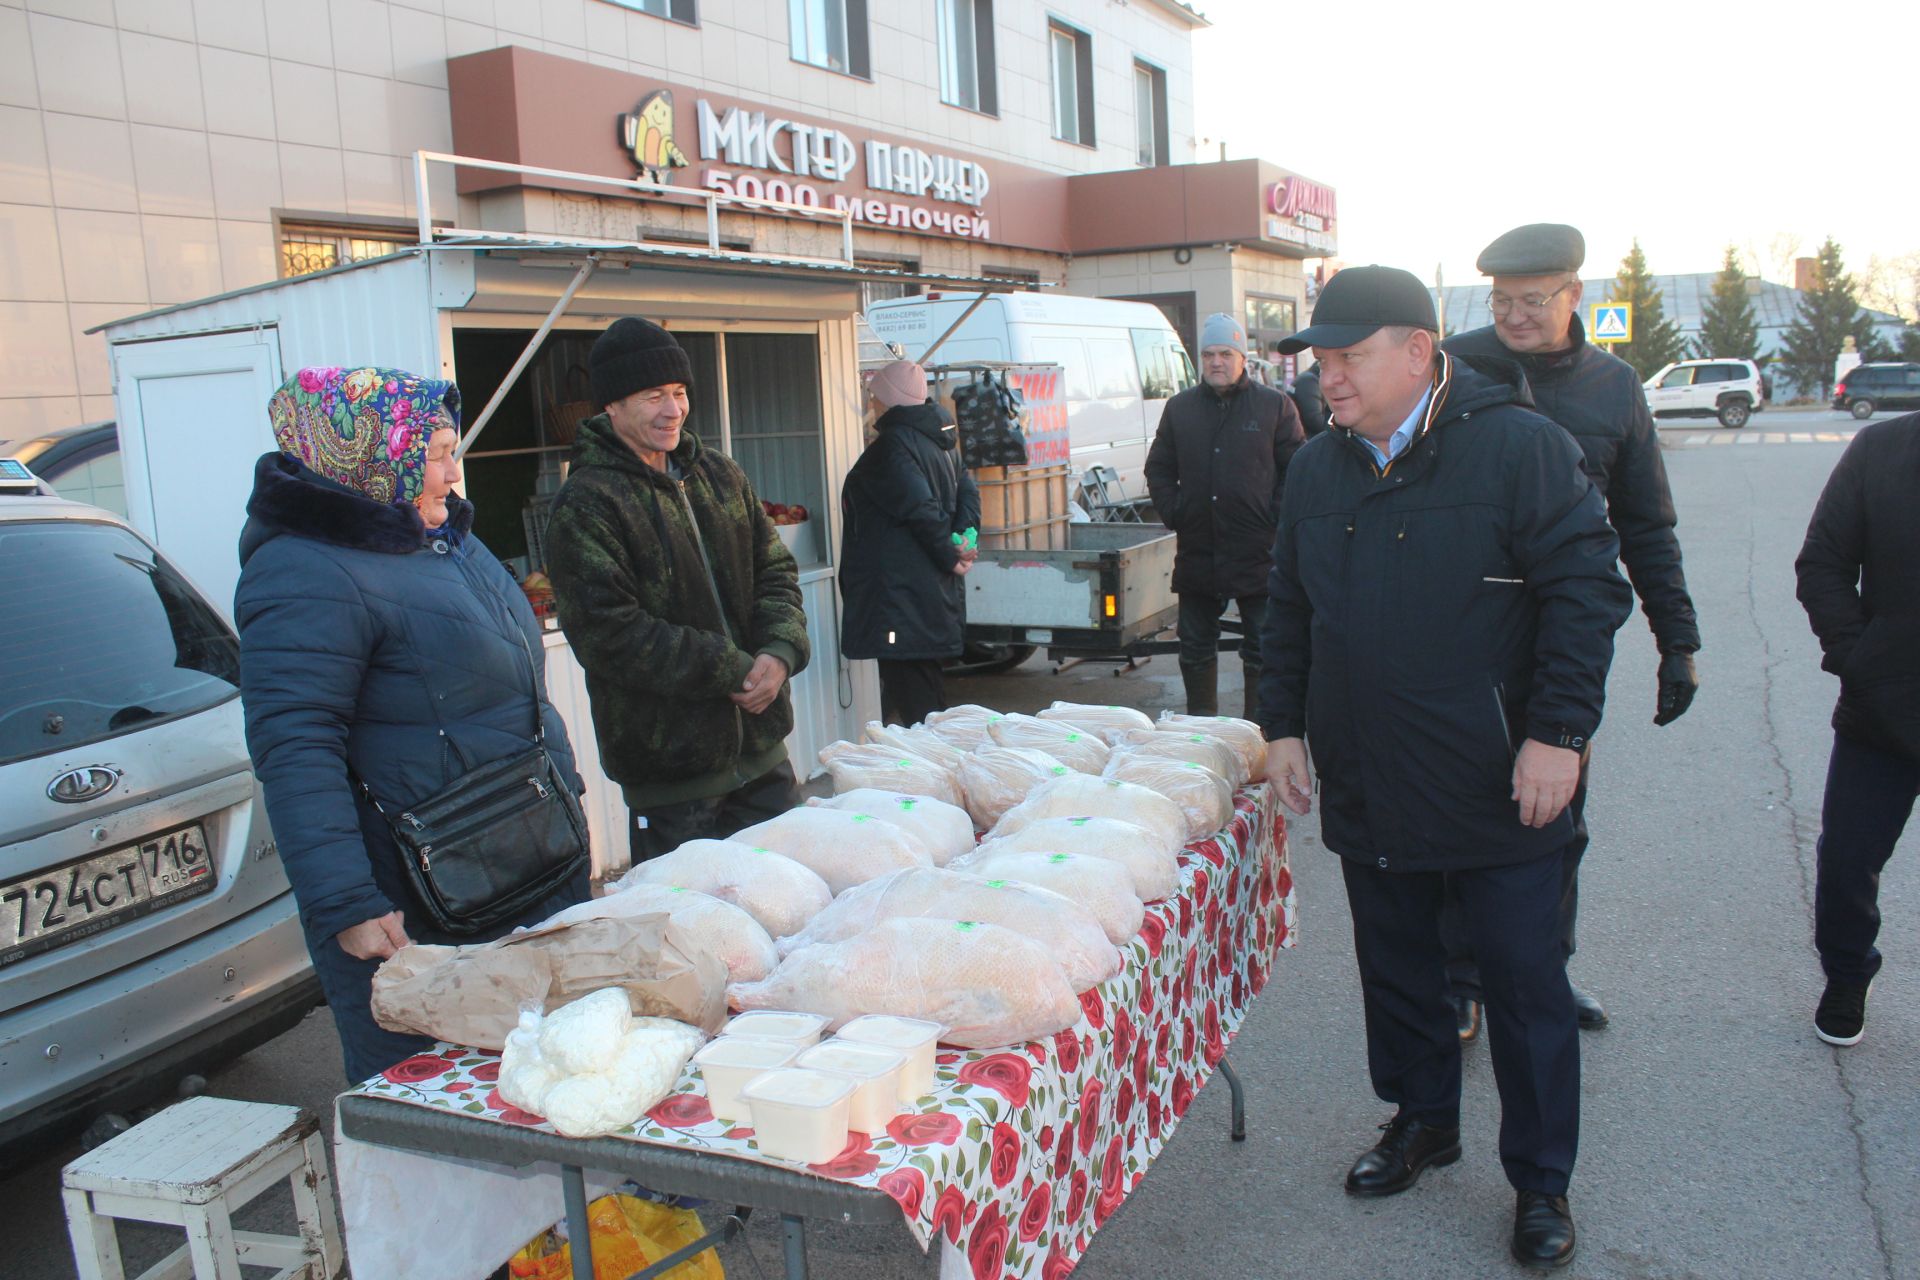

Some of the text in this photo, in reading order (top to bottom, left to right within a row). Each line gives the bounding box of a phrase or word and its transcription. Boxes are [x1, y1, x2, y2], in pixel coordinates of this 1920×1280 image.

[697, 99, 990, 206] МИСТЕР ПАРКЕР
[703, 169, 991, 239] 5000 мелочей
[142, 832, 198, 878] 716
[162, 868, 189, 886] RUS
